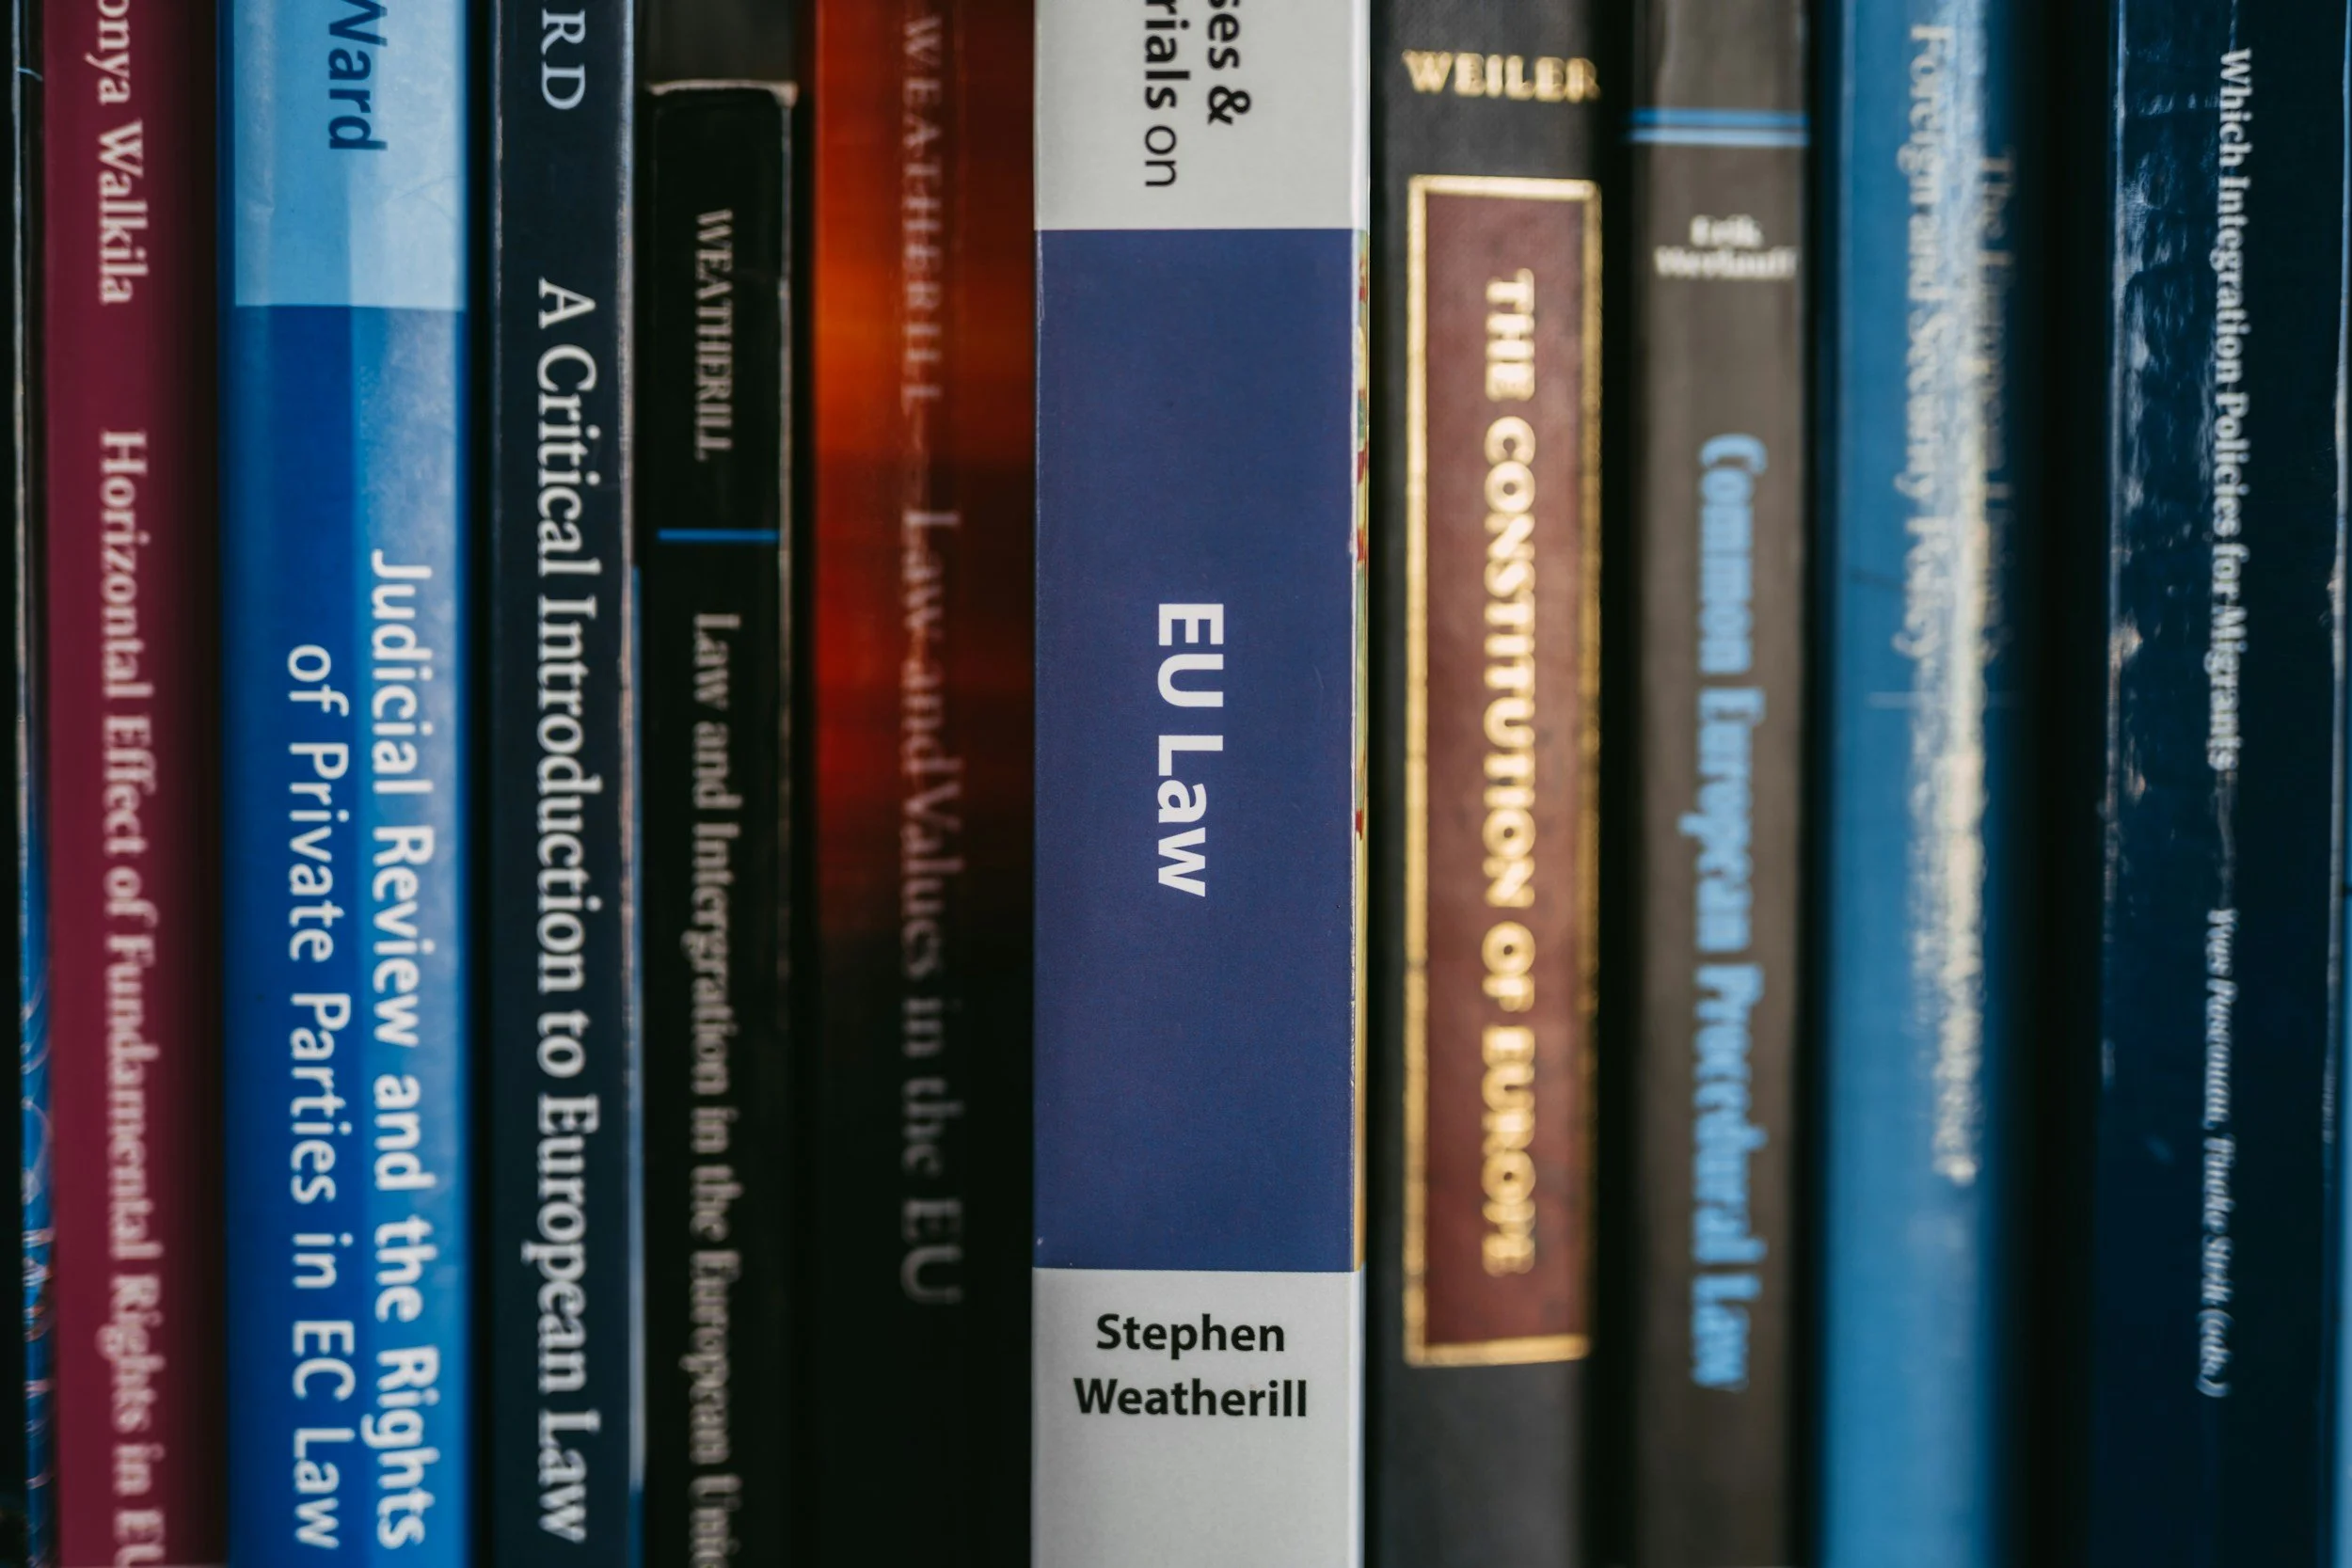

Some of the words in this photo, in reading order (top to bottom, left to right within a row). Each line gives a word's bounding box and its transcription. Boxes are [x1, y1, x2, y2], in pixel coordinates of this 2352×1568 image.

[1207, 86, 1251, 125] &
[1402, 49, 1600, 103] WEILER
[2218, 48, 2253, 167] Which
[98, 119, 149, 305] Walkila
[1145, 125, 1178, 187] on
[538, 277, 596, 329] A
[694, 209, 734, 462] WEATHERILL
[1484, 268, 1536, 403] THE
[2208, 176, 2250, 384] Integration
[537, 344, 601, 576] Critical
[2212, 391, 2251, 538] Policies
[101, 430, 153, 697] Horizontal
[901, 506, 961, 640] Law
[1698, 434, 1769, 674] Common
[2211, 543, 2251, 601] for
[288, 644, 349, 717] of
[372, 549, 434, 795] Judicial
[691, 612, 741, 709] Law
[900, 660, 963, 775] and
[1158, 603, 1224, 707] EU
[1482, 416, 1536, 909] CONSTITUTION
[2203, 603, 2249, 772] Migrants
[104, 715, 157, 855] Effect
[536, 594, 602, 993] Introduction
[692, 721, 743, 810] and
[1158, 735, 1224, 897] Law
[1677, 686, 1767, 952] European
[103, 866, 158, 927] of
[289, 741, 349, 962] Private
[900, 779, 962, 980] Values
[372, 825, 436, 1048] Review
[680, 821, 741, 1095] Intergration
[1481, 921, 1537, 1013] OF
[536, 1011, 593, 1078] to
[901, 995, 963, 1057] in
[105, 934, 163, 1260] Fundamental
[290, 992, 352, 1205] Parties
[373, 1073, 437, 1191] and
[691, 1106, 739, 1153] in
[901, 1076, 964, 1175] the
[1480, 1024, 1537, 1278] EUROPE
[1692, 962, 1769, 1265] Procedural
[291, 1232, 354, 1289] in
[374, 1215, 438, 1323] the
[520, 1093, 599, 1394] European
[691, 1164, 743, 1242] the
[899, 1196, 963, 1304] EU
[94, 1274, 167, 1434] Rights
[292, 1319, 357, 1402] EC
[678, 1249, 743, 1465] European
[1073, 1377, 1307, 1417] Weatherill
[1096, 1313, 1285, 1360] Stephen
[1691, 1273, 1764, 1393] Law
[111, 1443, 167, 1497] in
[293, 1427, 356, 1549] Law
[360, 1346, 440, 1550] Rights
[537, 1408, 600, 1544] Law
